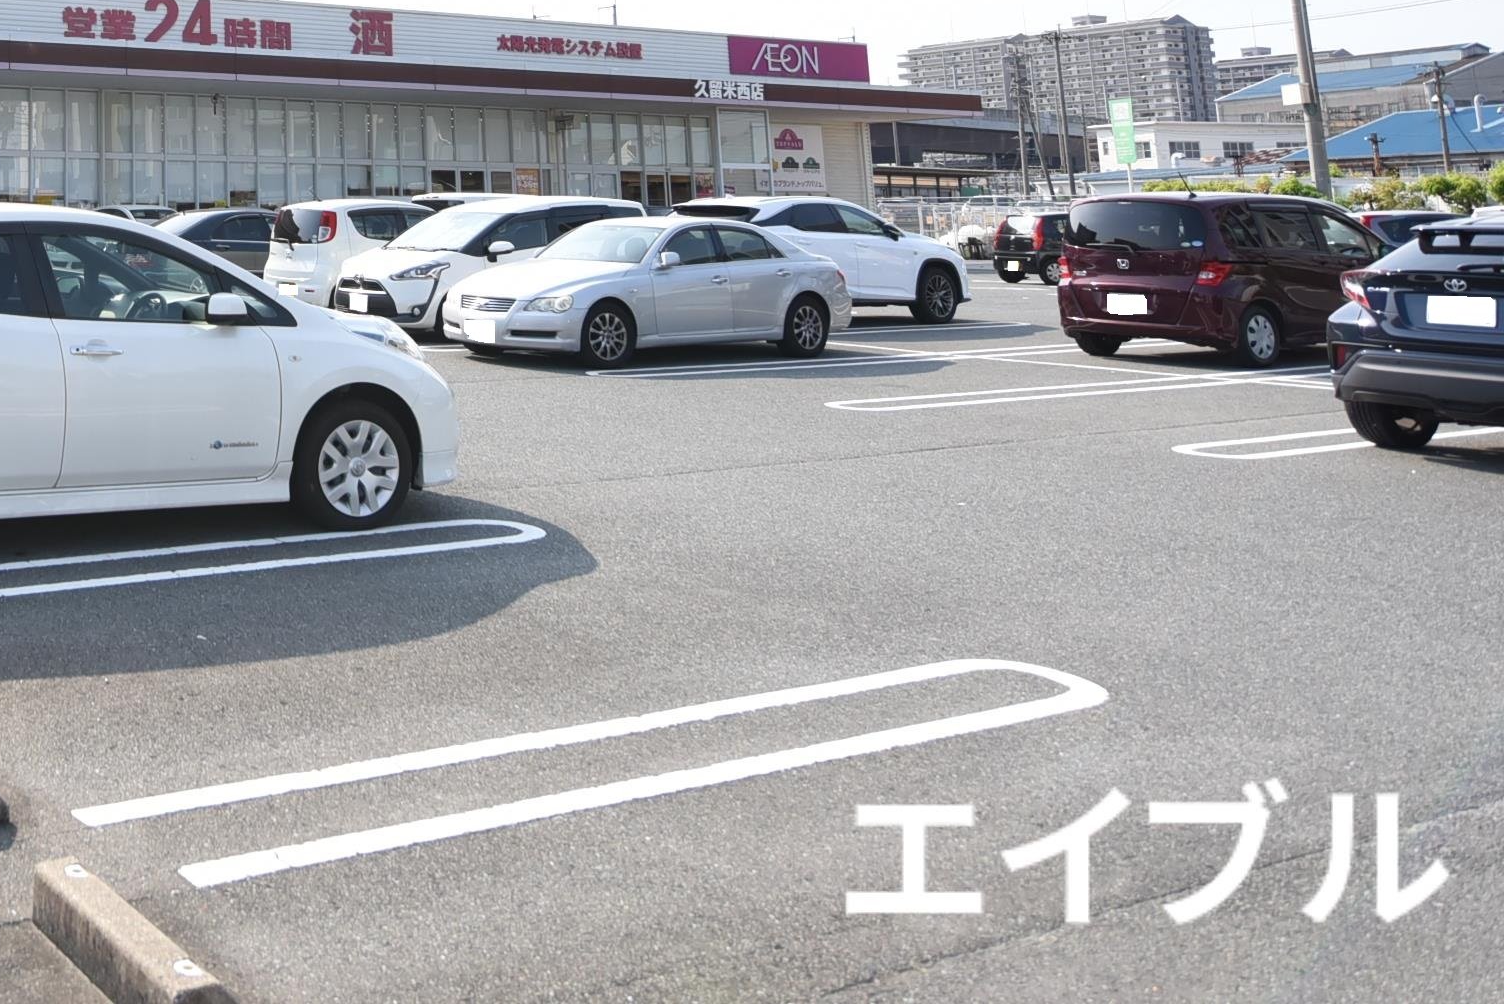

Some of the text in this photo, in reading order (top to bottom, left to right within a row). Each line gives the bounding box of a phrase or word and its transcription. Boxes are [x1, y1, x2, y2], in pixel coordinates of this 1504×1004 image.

[348, 9, 394, 57] 酒
[694, 79, 765, 101] 久留米西店
